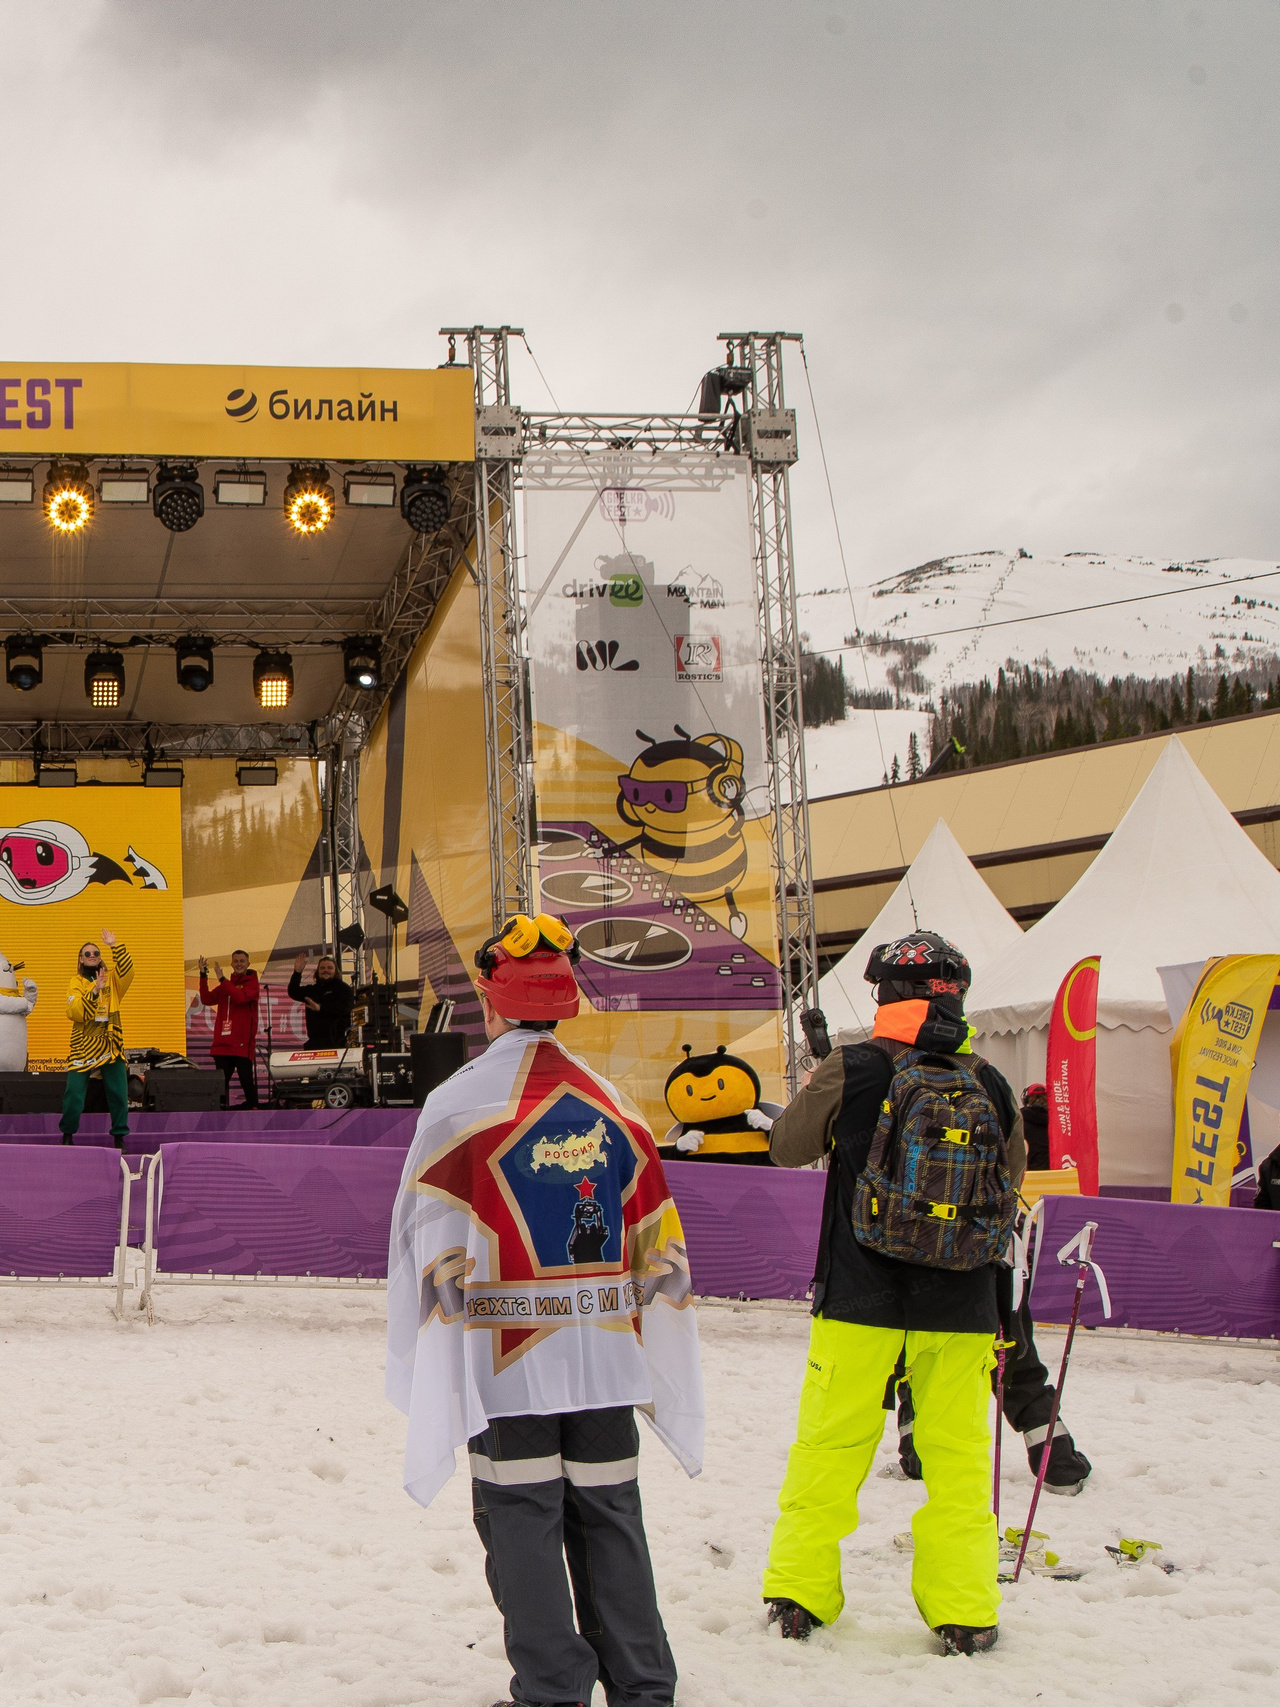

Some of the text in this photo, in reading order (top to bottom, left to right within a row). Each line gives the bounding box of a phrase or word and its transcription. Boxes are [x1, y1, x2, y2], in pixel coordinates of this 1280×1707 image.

[269, 388, 398, 422] билайн
[606, 492, 643, 504] GRELKA
[606, 505, 631, 516] FEST
[562, 578, 641, 601] drivee
[677, 673, 721, 681] ROSTIC'S
[1053, 1080, 1064, 1103] RIDE
[1061, 1058, 1070, 1104] FESTIVAL
[544, 1141, 595, 1160] РОССИЯ
[907, 1145, 922, 1193] DAKINE
[534, 1297, 572, 1316] им
[576, 1289, 594, 1315] С
[597, 1287, 619, 1313] М
